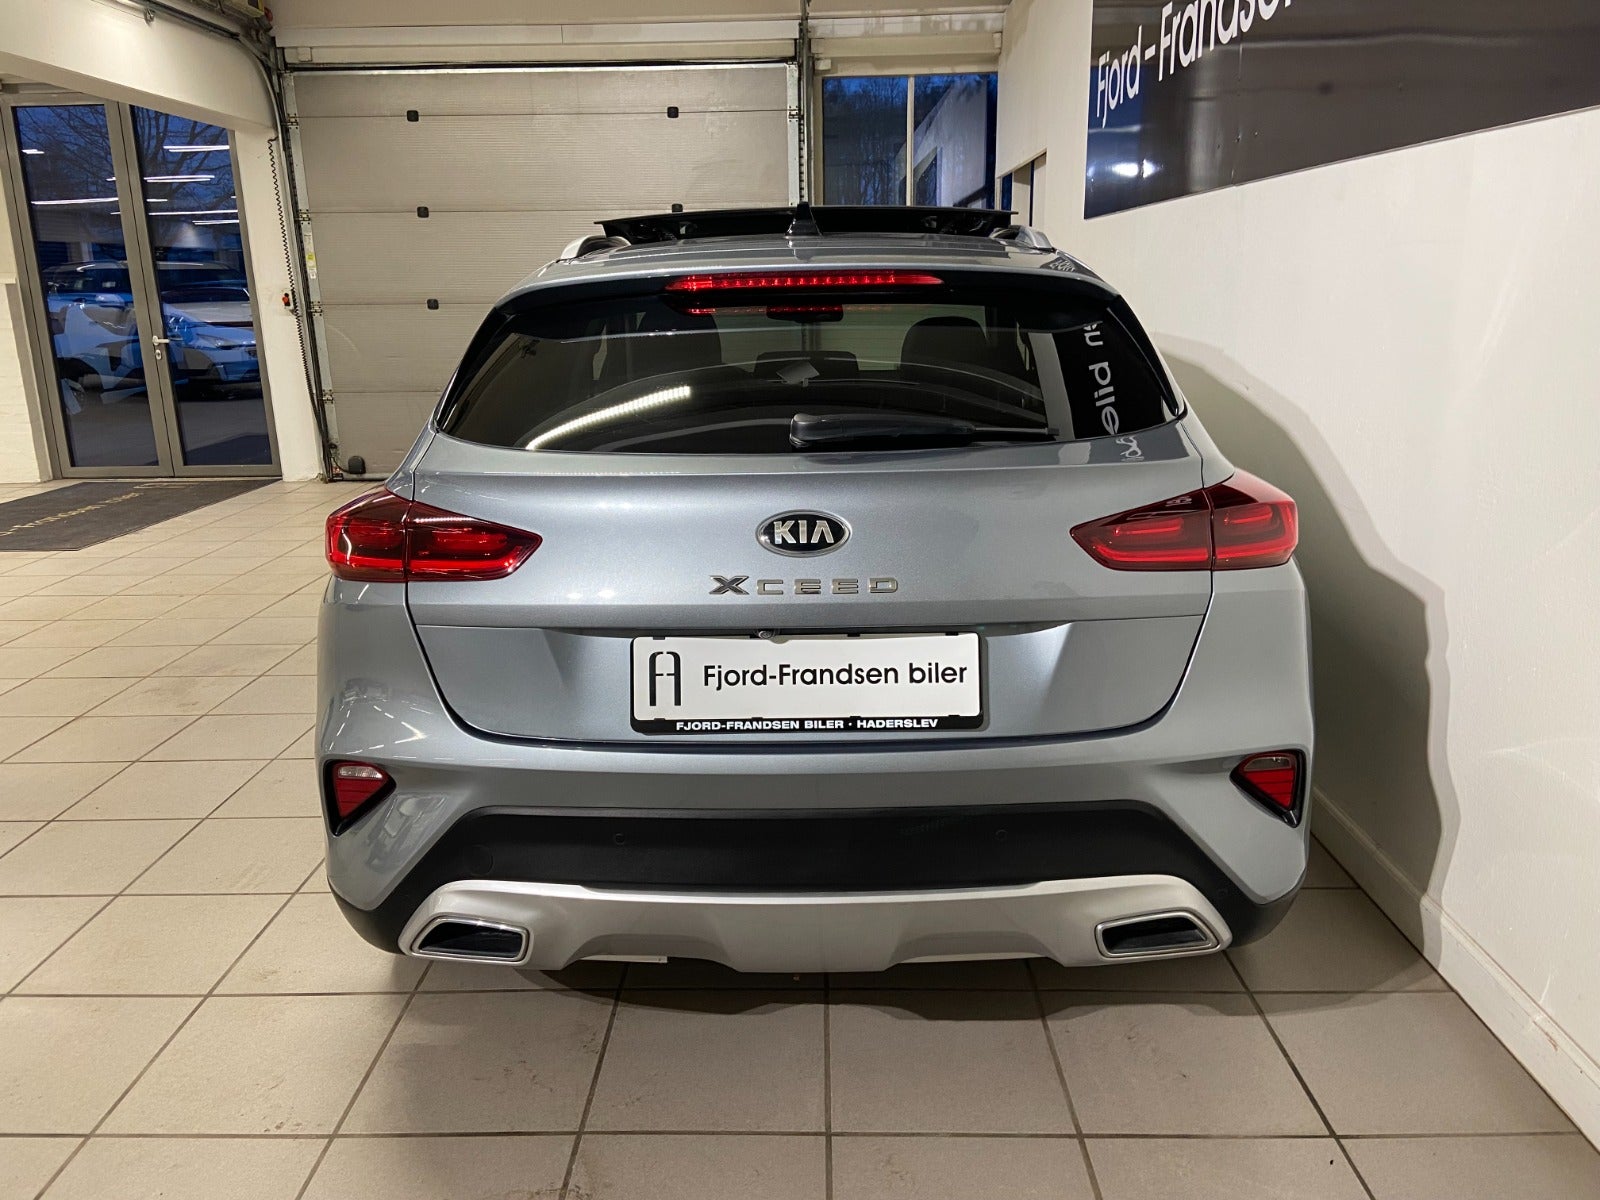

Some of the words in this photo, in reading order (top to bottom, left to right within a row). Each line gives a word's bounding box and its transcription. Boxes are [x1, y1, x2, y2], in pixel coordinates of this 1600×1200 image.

[1097, 0, 1292, 128] Fjord-Frands
[773, 520, 835, 544] KIA
[708, 575, 898, 596] XCEED
[703, 663, 899, 691] Fjord-Frandsen
[908, 662, 968, 684] biler
[676, 720, 800, 731] FJORD-FRANDSEN
[804, 720, 844, 729] BILER
[856, 719, 938, 729] HADERSLEV
